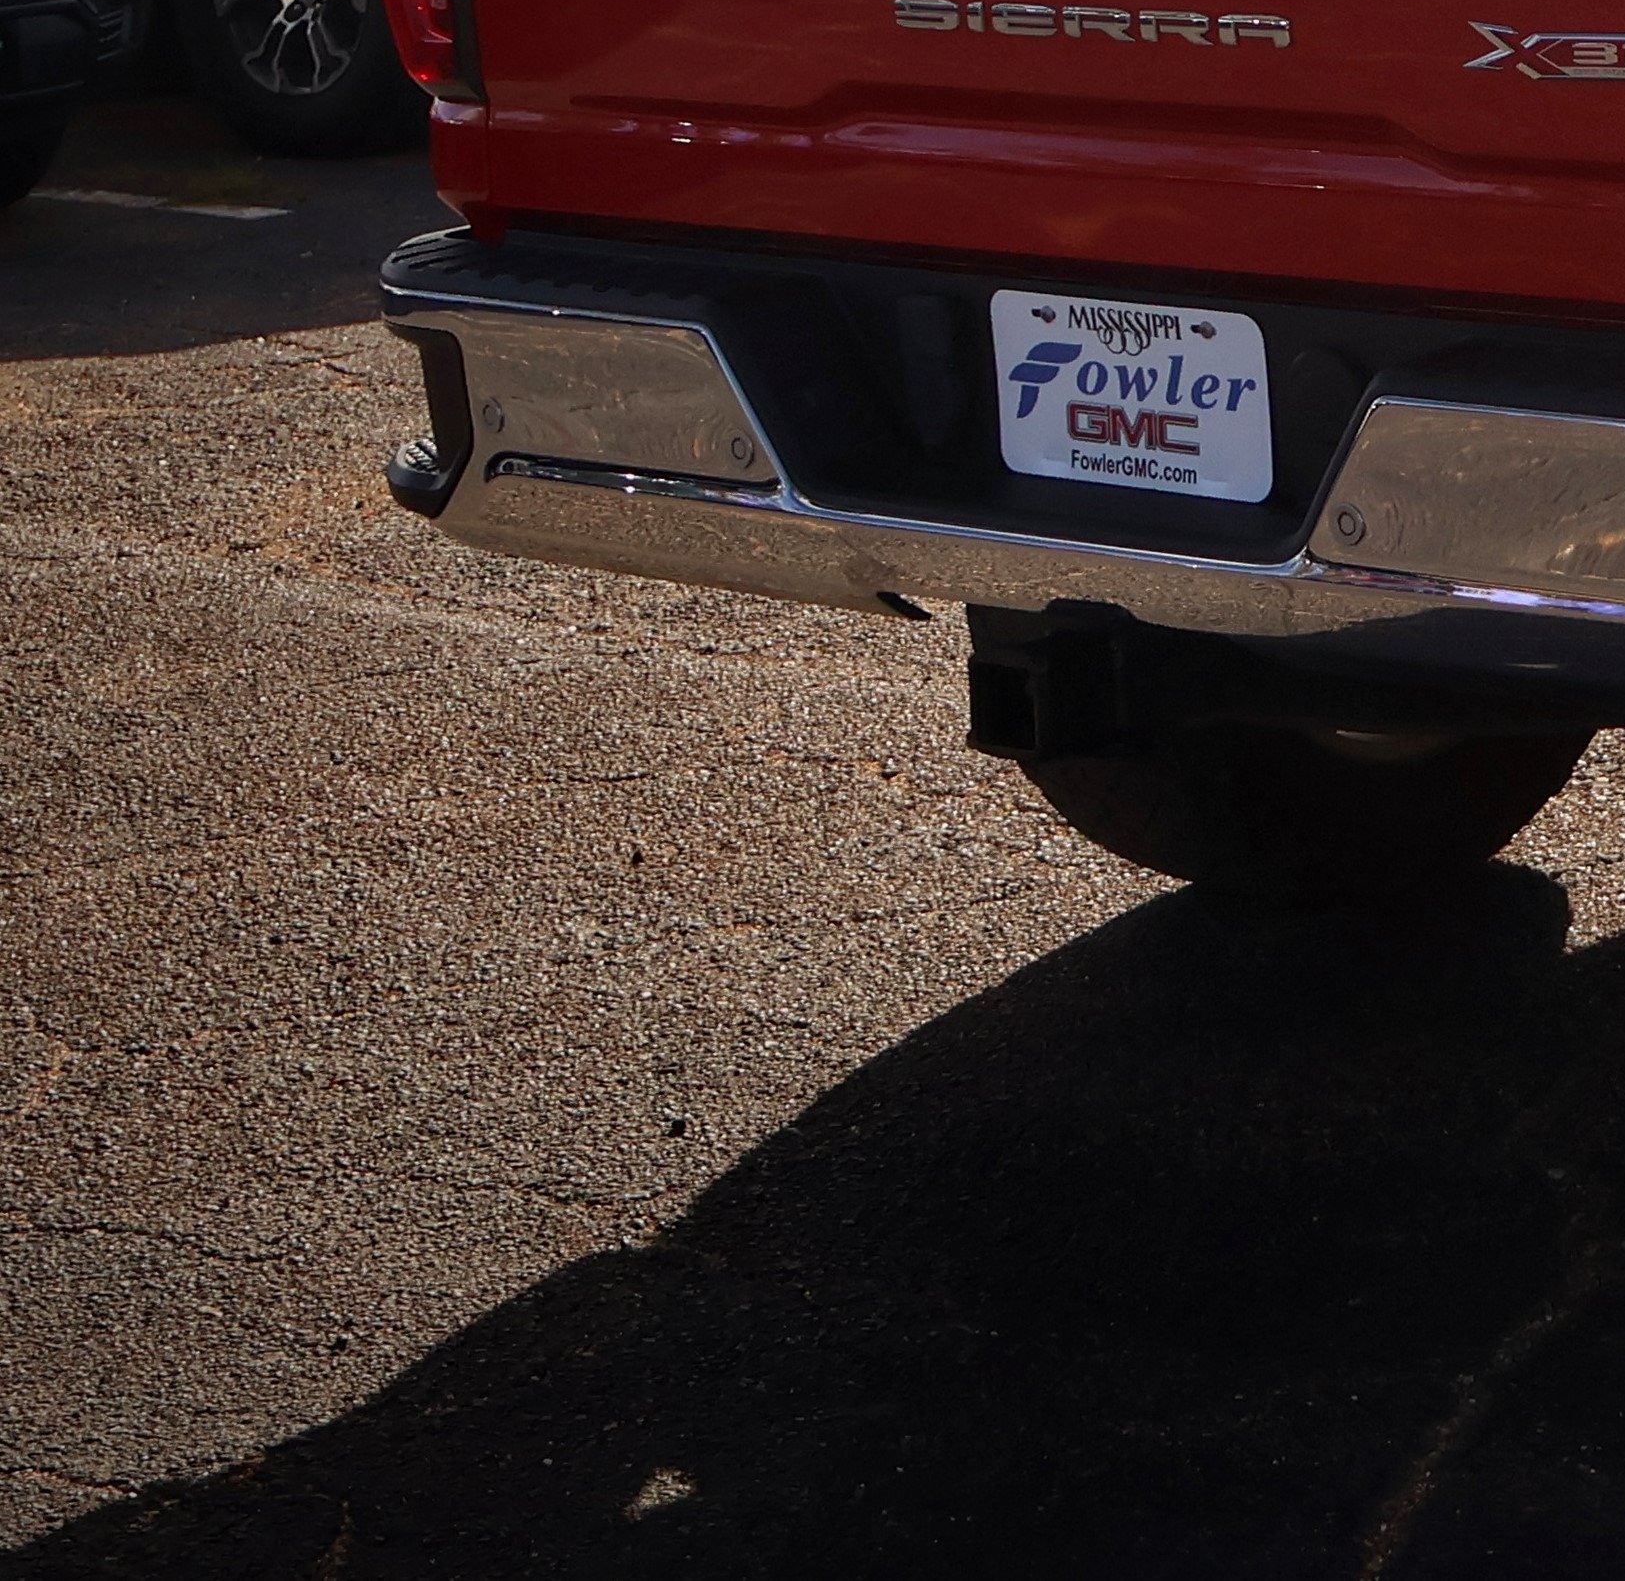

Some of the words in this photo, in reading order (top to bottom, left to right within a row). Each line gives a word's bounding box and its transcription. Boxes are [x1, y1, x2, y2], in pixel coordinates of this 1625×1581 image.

[1068, 305, 1182, 357] MISSISSIPPI
[1008, 341, 1257, 419] Fowler
[1066, 400, 1200, 455] GMC
[1070, 449, 1198, 485] FowlerGMC.com
